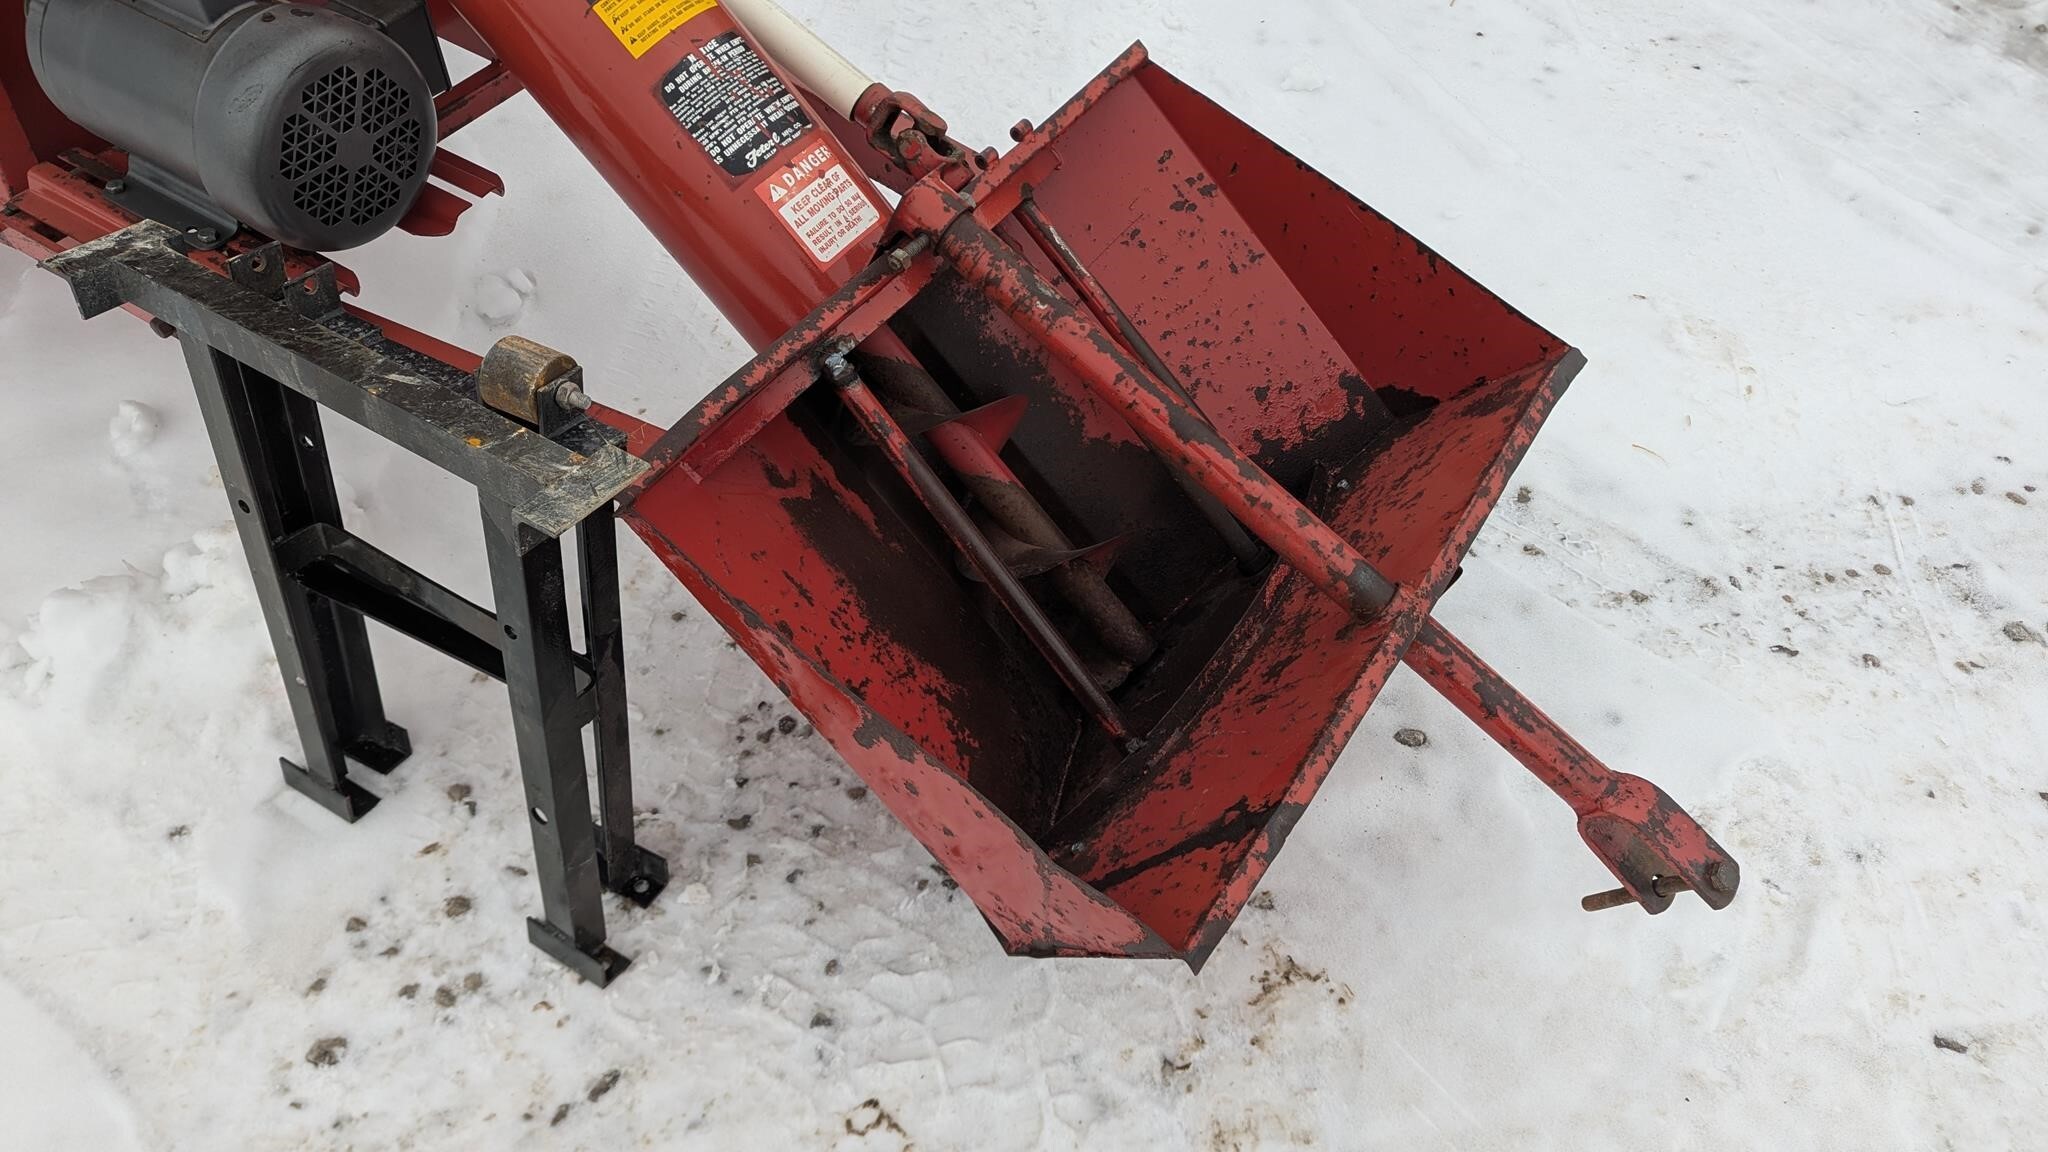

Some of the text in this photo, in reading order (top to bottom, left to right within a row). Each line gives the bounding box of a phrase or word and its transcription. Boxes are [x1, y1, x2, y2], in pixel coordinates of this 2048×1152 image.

[686, 37, 719, 63] NTICE
[664, 82, 675, 93] DO
[674, 70, 689, 84] NOT
[688, 51, 715, 73] OPERTE
[714, 42, 731, 55] WHEN
[678, 72, 702, 93] DURING
[709, 145, 721, 157] DO
[720, 133, 736, 147] NOT
[780, 143, 833, 187] DANGER
[790, 171, 841, 214] KEEP CLEAR OF
[792, 177, 853, 228] ALL MOVING PARTS
[805, 217, 828, 239] FAILURE
[827, 210, 837, 220] TO
[835, 204, 845, 213] DO
[843, 198, 852, 207] SO
[811, 225, 834, 246] RESULT
[834, 218, 842, 227] IN
[817, 234, 838, 254] INJURY
[836, 227, 847, 238] OR
